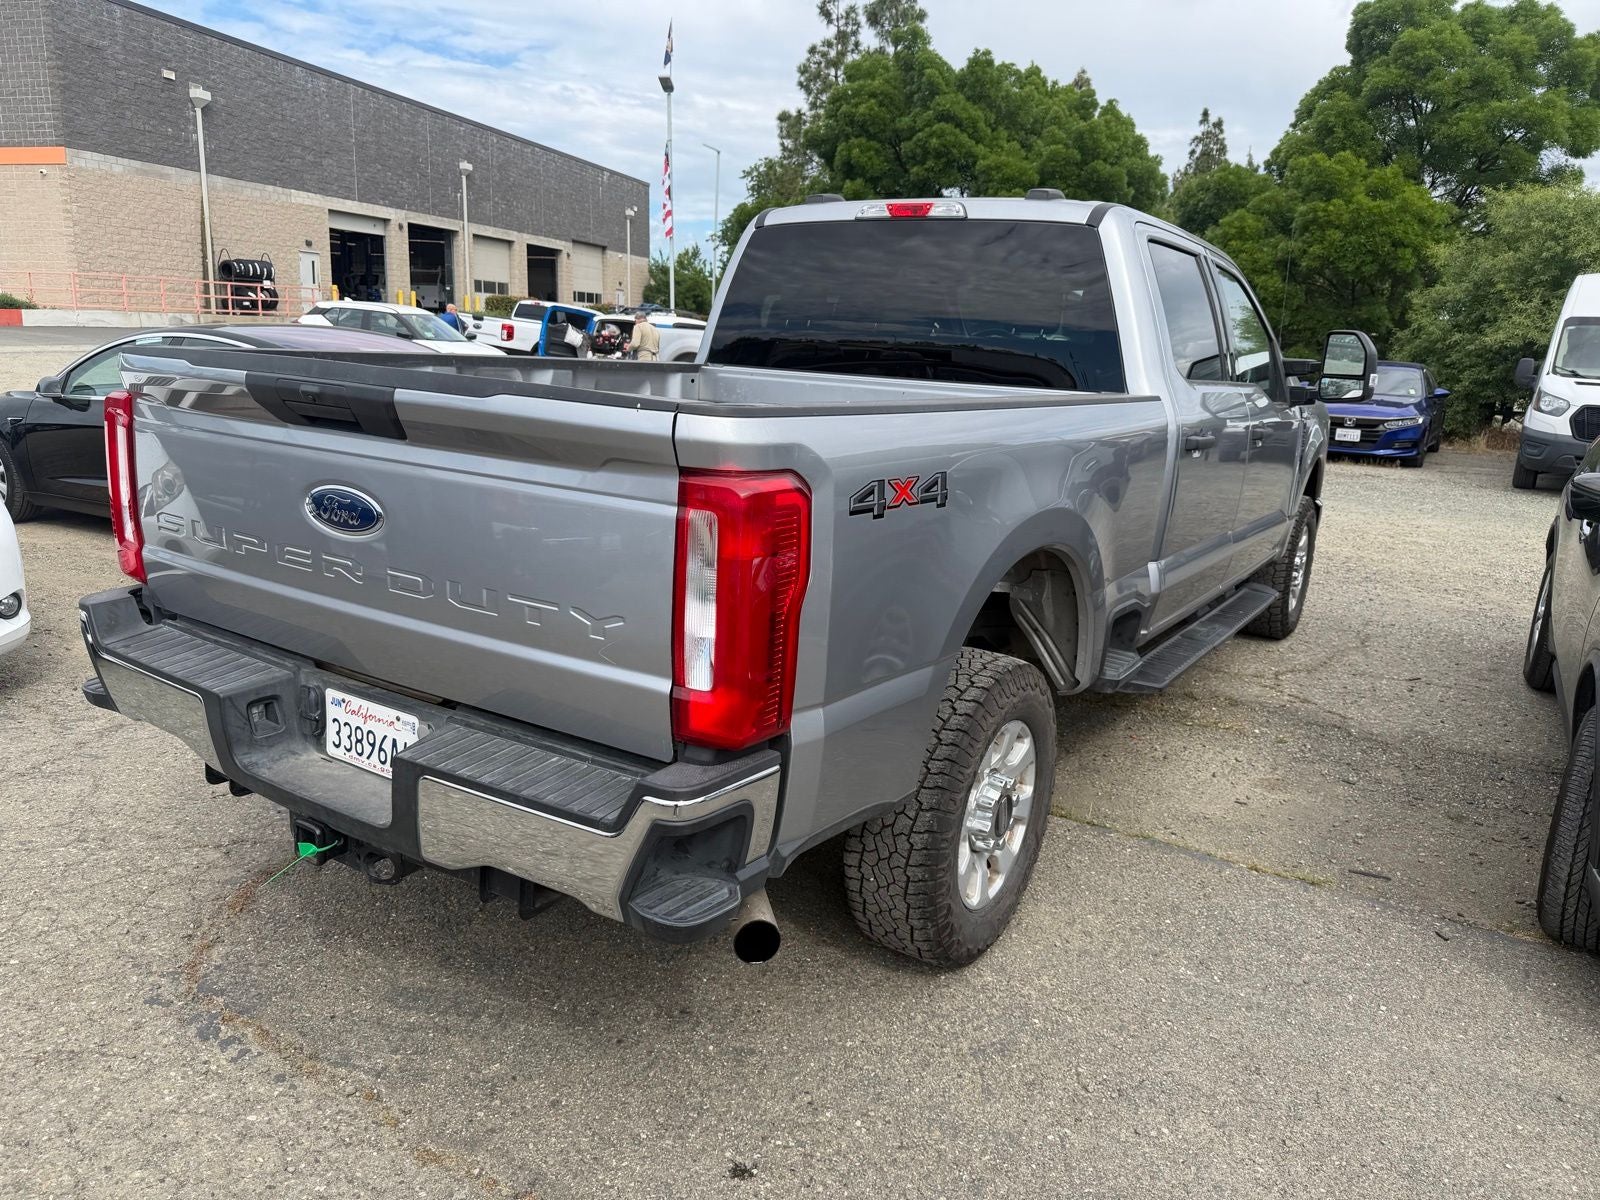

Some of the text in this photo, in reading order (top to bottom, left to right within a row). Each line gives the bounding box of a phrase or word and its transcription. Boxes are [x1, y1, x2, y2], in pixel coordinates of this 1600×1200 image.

[320, 494, 361, 526] Ford
[155, 510, 626, 640] SUPER DUTY
[330, 696, 342, 708] JUN
[344, 700, 402, 732] California
[332, 717, 408, 768] 33896A
[348, 755, 393, 775] dmv.ca.go
